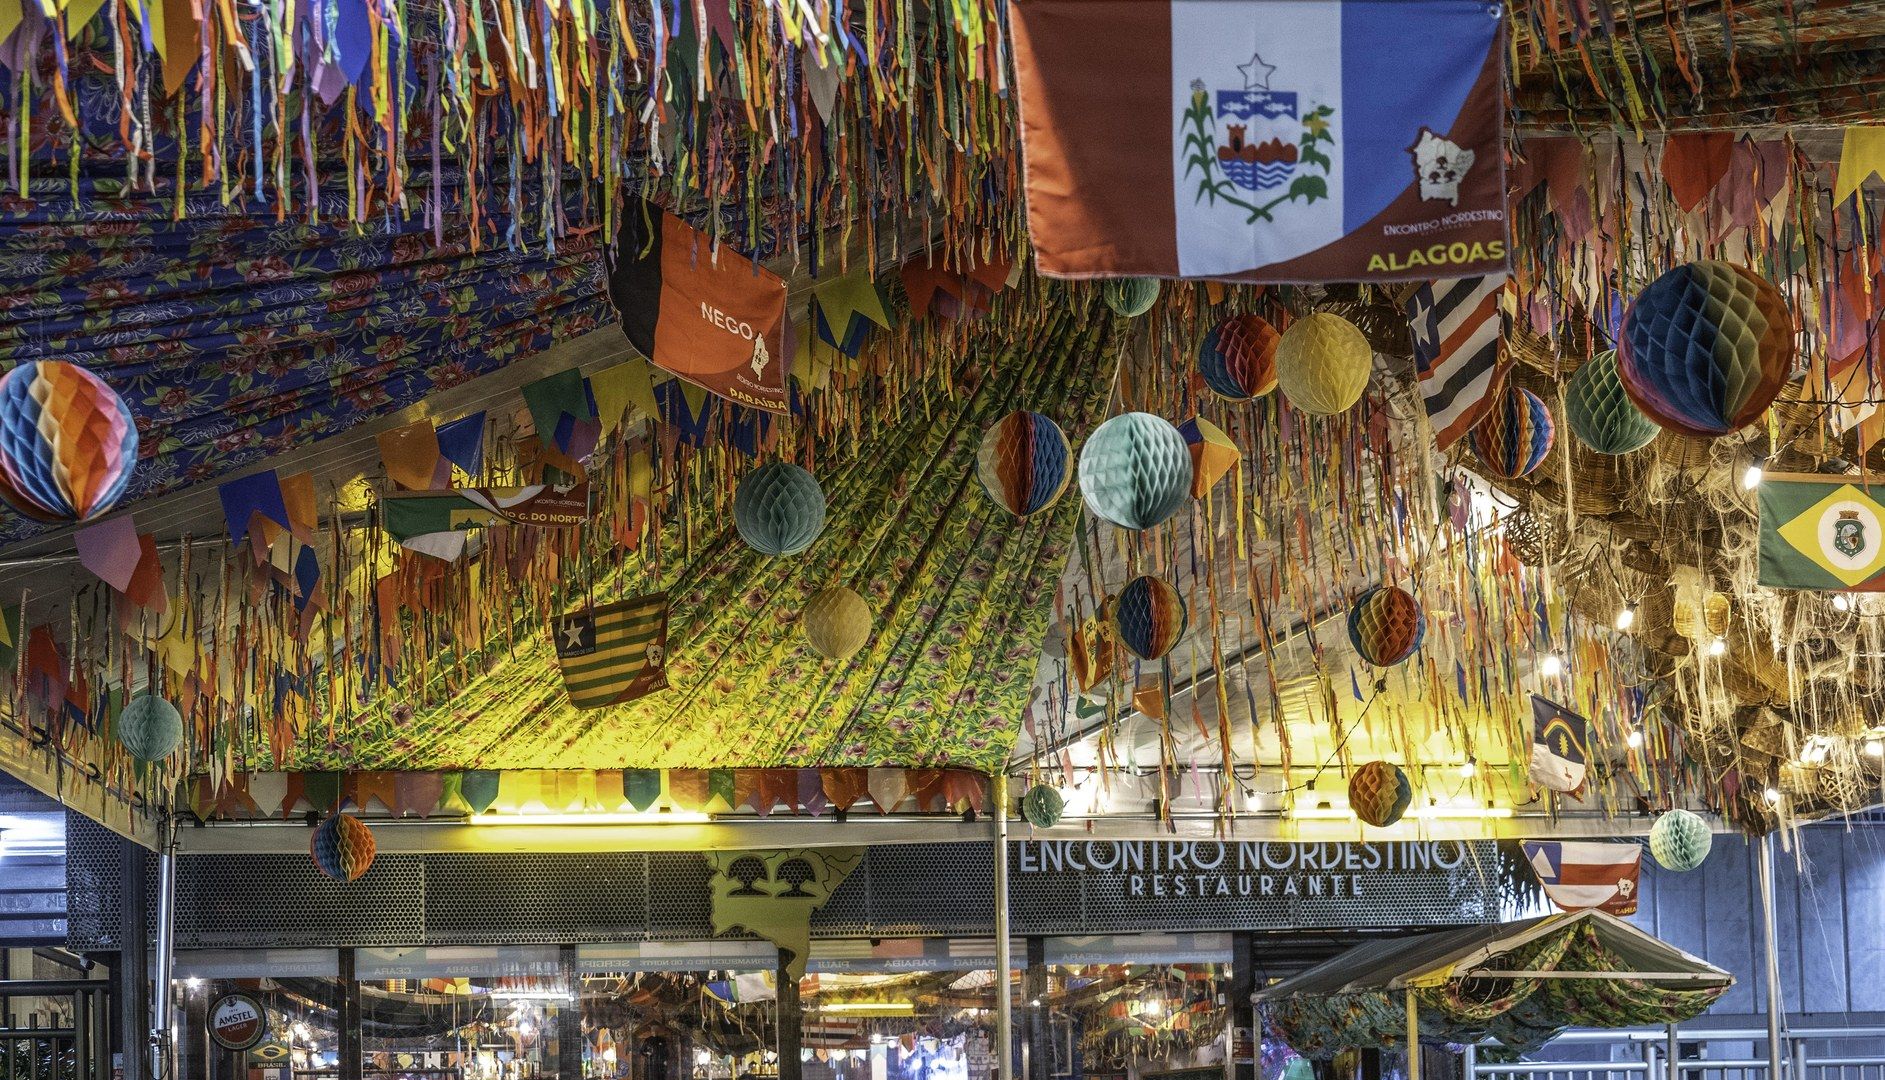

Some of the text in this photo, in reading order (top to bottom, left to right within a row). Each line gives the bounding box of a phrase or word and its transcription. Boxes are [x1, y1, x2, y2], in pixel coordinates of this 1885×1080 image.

[1383, 219, 1440, 236] ENCONTRO
[1442, 209, 1504, 225] NORDESTINO
[1367, 240, 1506, 272] ALAGOAS
[701, 301, 753, 340] NEGO
[730, 387, 787, 411] PARAÍBA
[531, 512, 547, 522] DO
[1019, 839, 1466, 872] ENCONTRO NORDESTINO
[1131, 875, 1364, 896] RESTAURANTE
[1615, 906, 1637, 915] BAHIA
[219, 1010, 253, 1027] AMSTEL
[227, 1022, 249, 1032] LAGER
